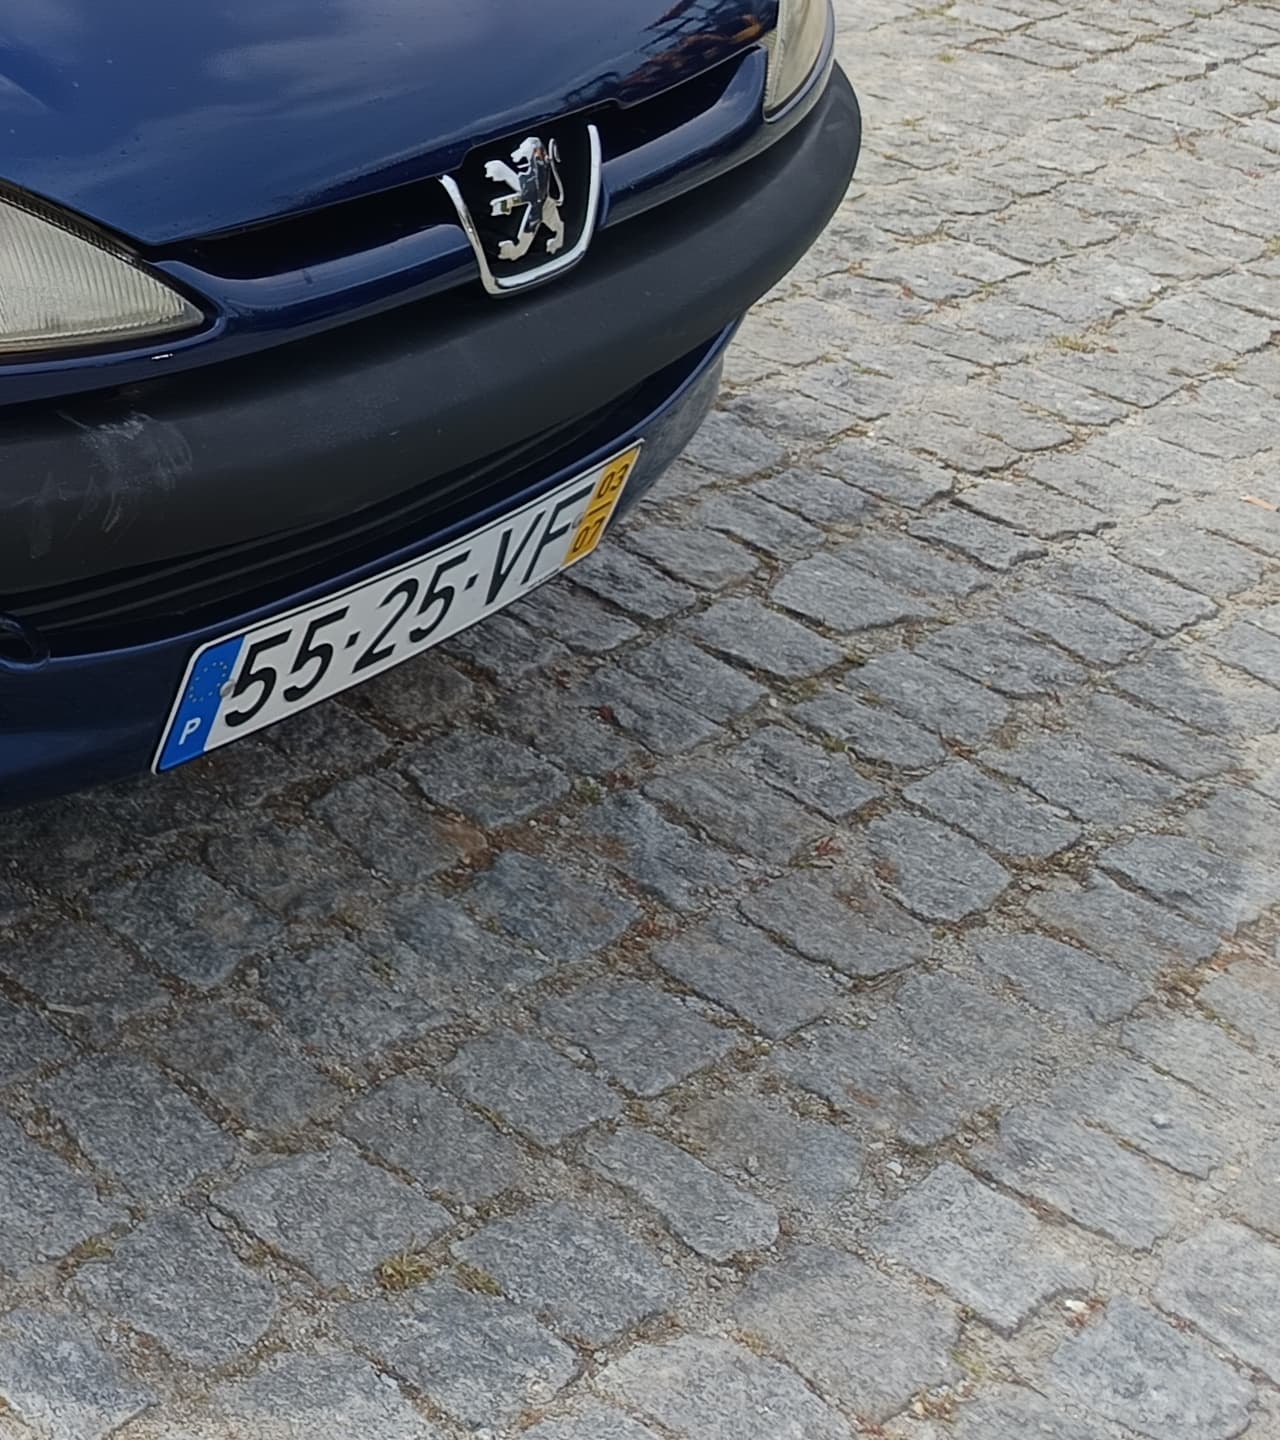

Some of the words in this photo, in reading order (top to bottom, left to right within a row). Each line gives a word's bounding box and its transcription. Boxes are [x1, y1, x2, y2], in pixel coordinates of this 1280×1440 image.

[597, 463, 630, 499] 03
[572, 515, 606, 553] 07
[178, 717, 201, 746] P
